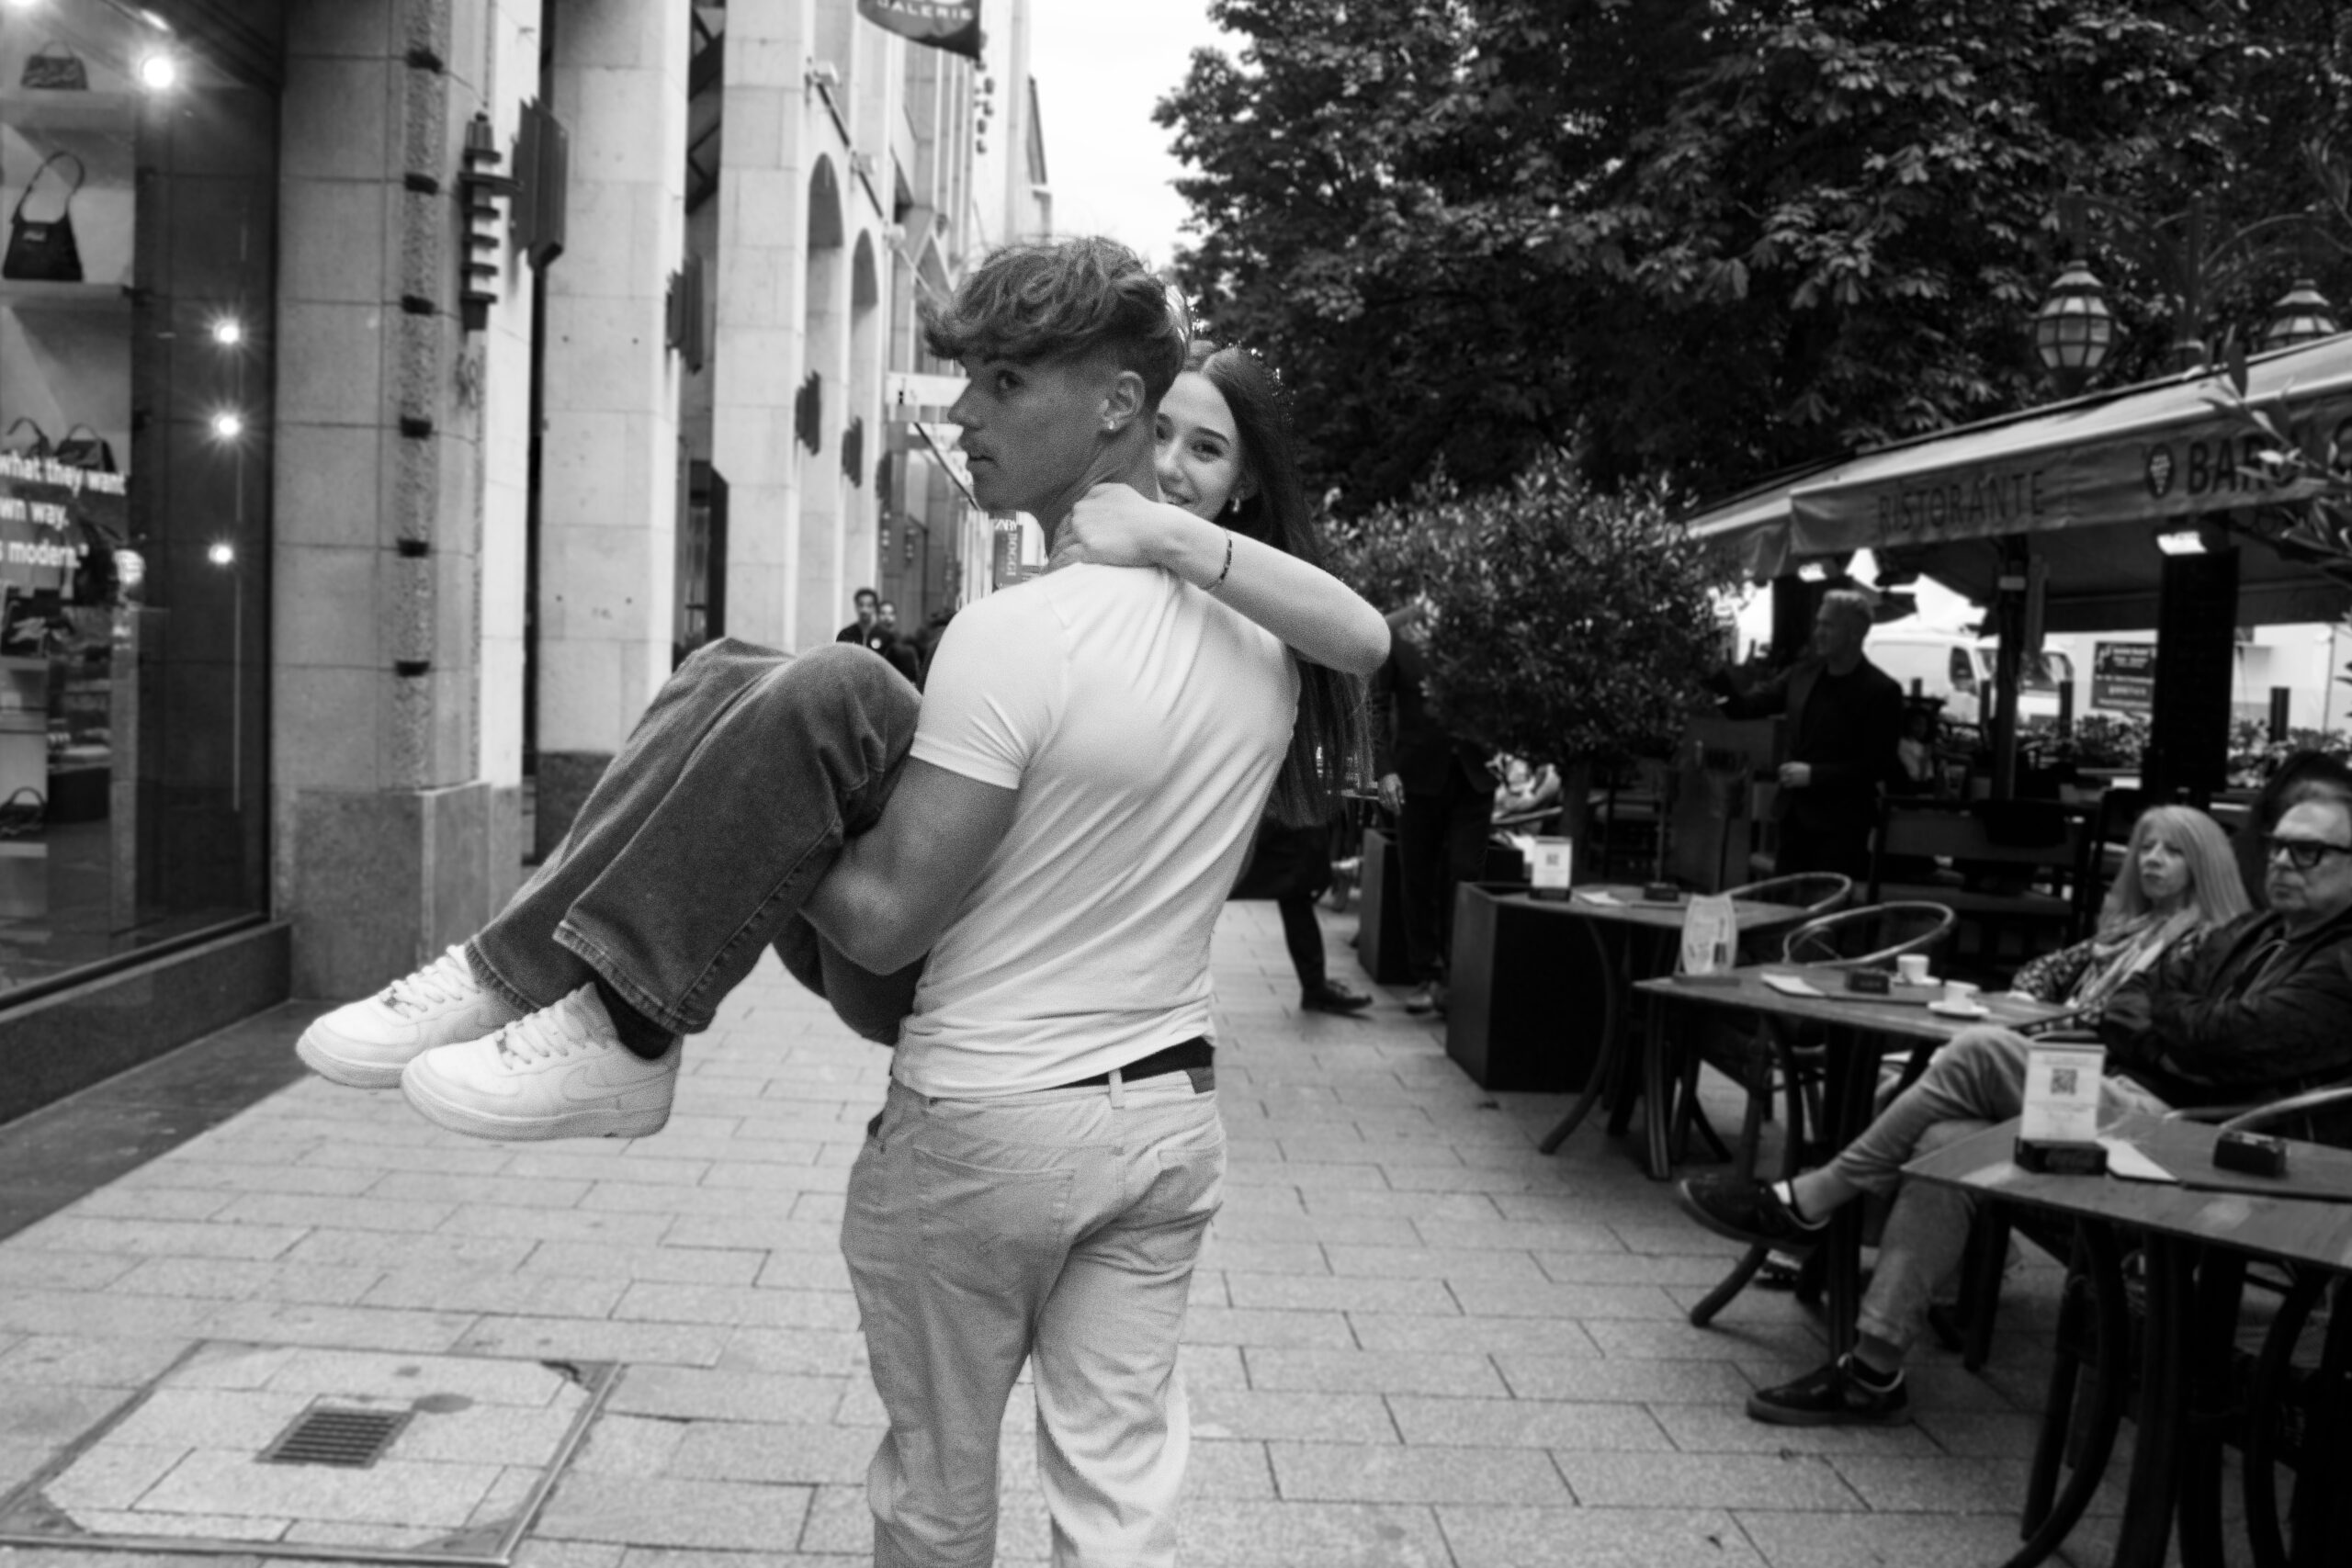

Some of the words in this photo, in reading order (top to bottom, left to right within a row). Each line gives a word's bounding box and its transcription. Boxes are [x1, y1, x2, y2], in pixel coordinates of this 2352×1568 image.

[45, 457, 83, 497] they
[86, 469, 127, 496] want
[29, 501, 70, 531] way.
[1879, 469, 2044, 533] RISTORANTE
[1006, 533, 1017, 577] BOGGI
